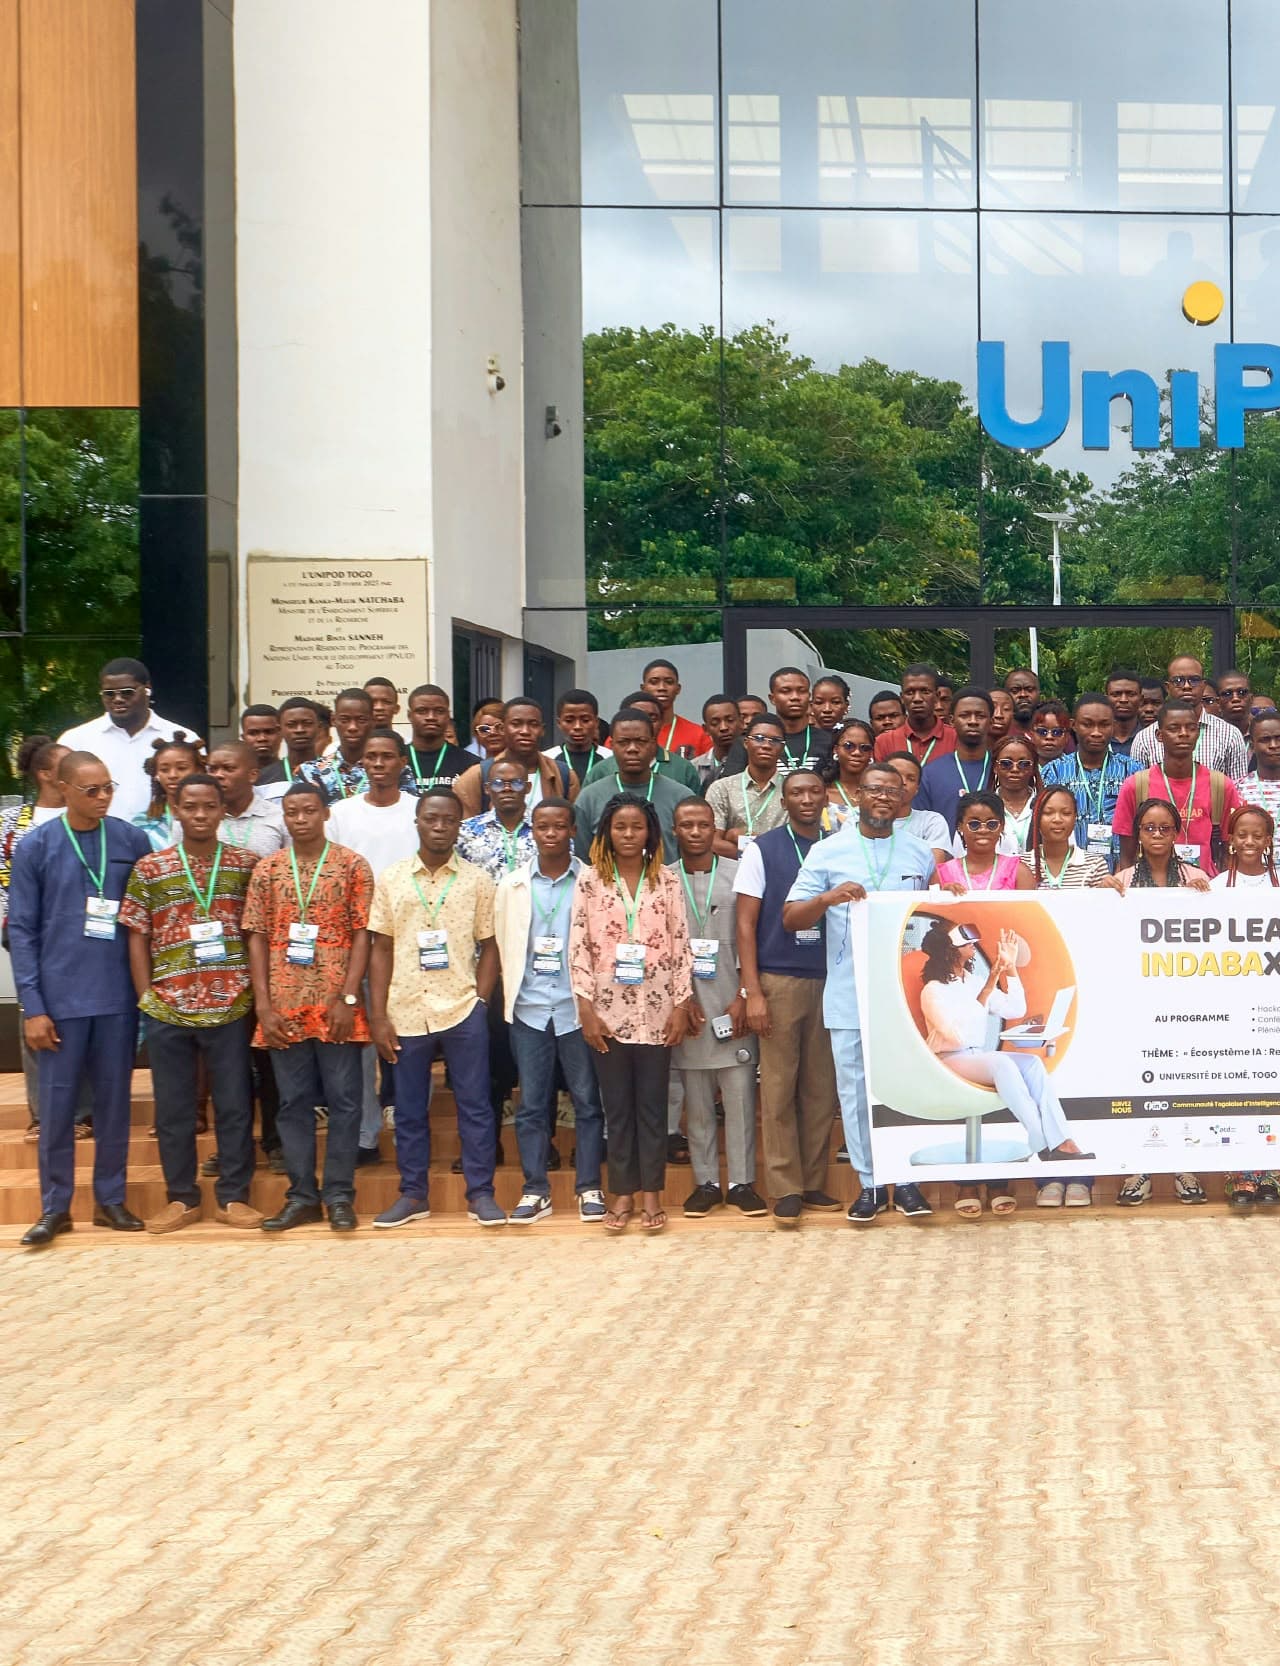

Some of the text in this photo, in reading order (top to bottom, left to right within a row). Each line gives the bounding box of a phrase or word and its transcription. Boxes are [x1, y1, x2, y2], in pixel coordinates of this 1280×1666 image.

[1140, 918, 1221, 943] DEEP
[1154, 1014, 1230, 1023] AU PROGRAMME
[1190, 1047, 1250, 1059] Écosystème
[1252, 1048, 1262, 1056] IA
[1159, 1069, 1278, 1080] UNIVERSITÉ DE LOMÉ, TOGO
